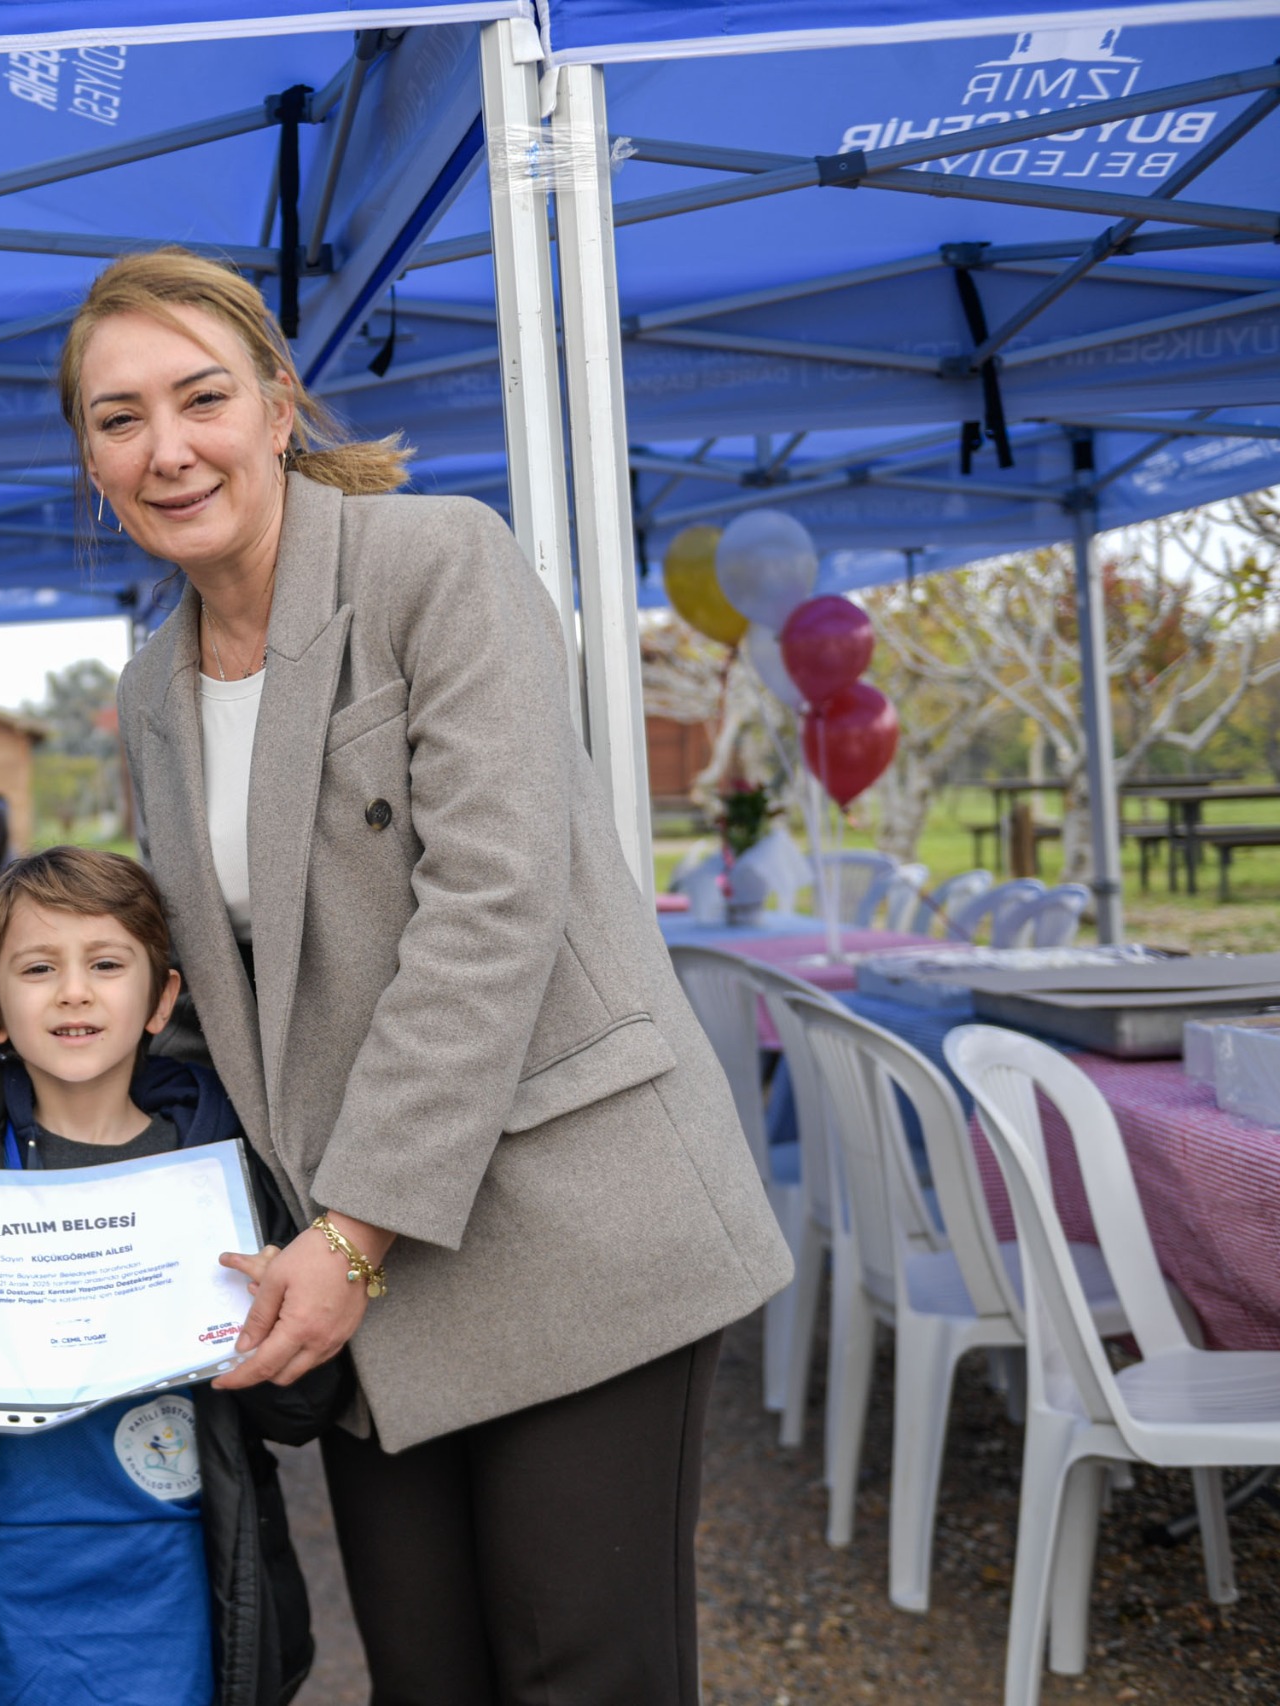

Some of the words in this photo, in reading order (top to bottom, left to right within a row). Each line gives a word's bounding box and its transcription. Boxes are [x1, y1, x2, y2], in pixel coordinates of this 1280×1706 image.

[61, 1212, 137, 1232] BELGESİ
[0, 1254, 24, 1264] Sayın
[31, 1250, 104, 1264] KÜÇÜKGÖRMEN
[105, 1244, 133, 1257] AİLESİ
[48, 1287, 77, 1296] Kentsel
